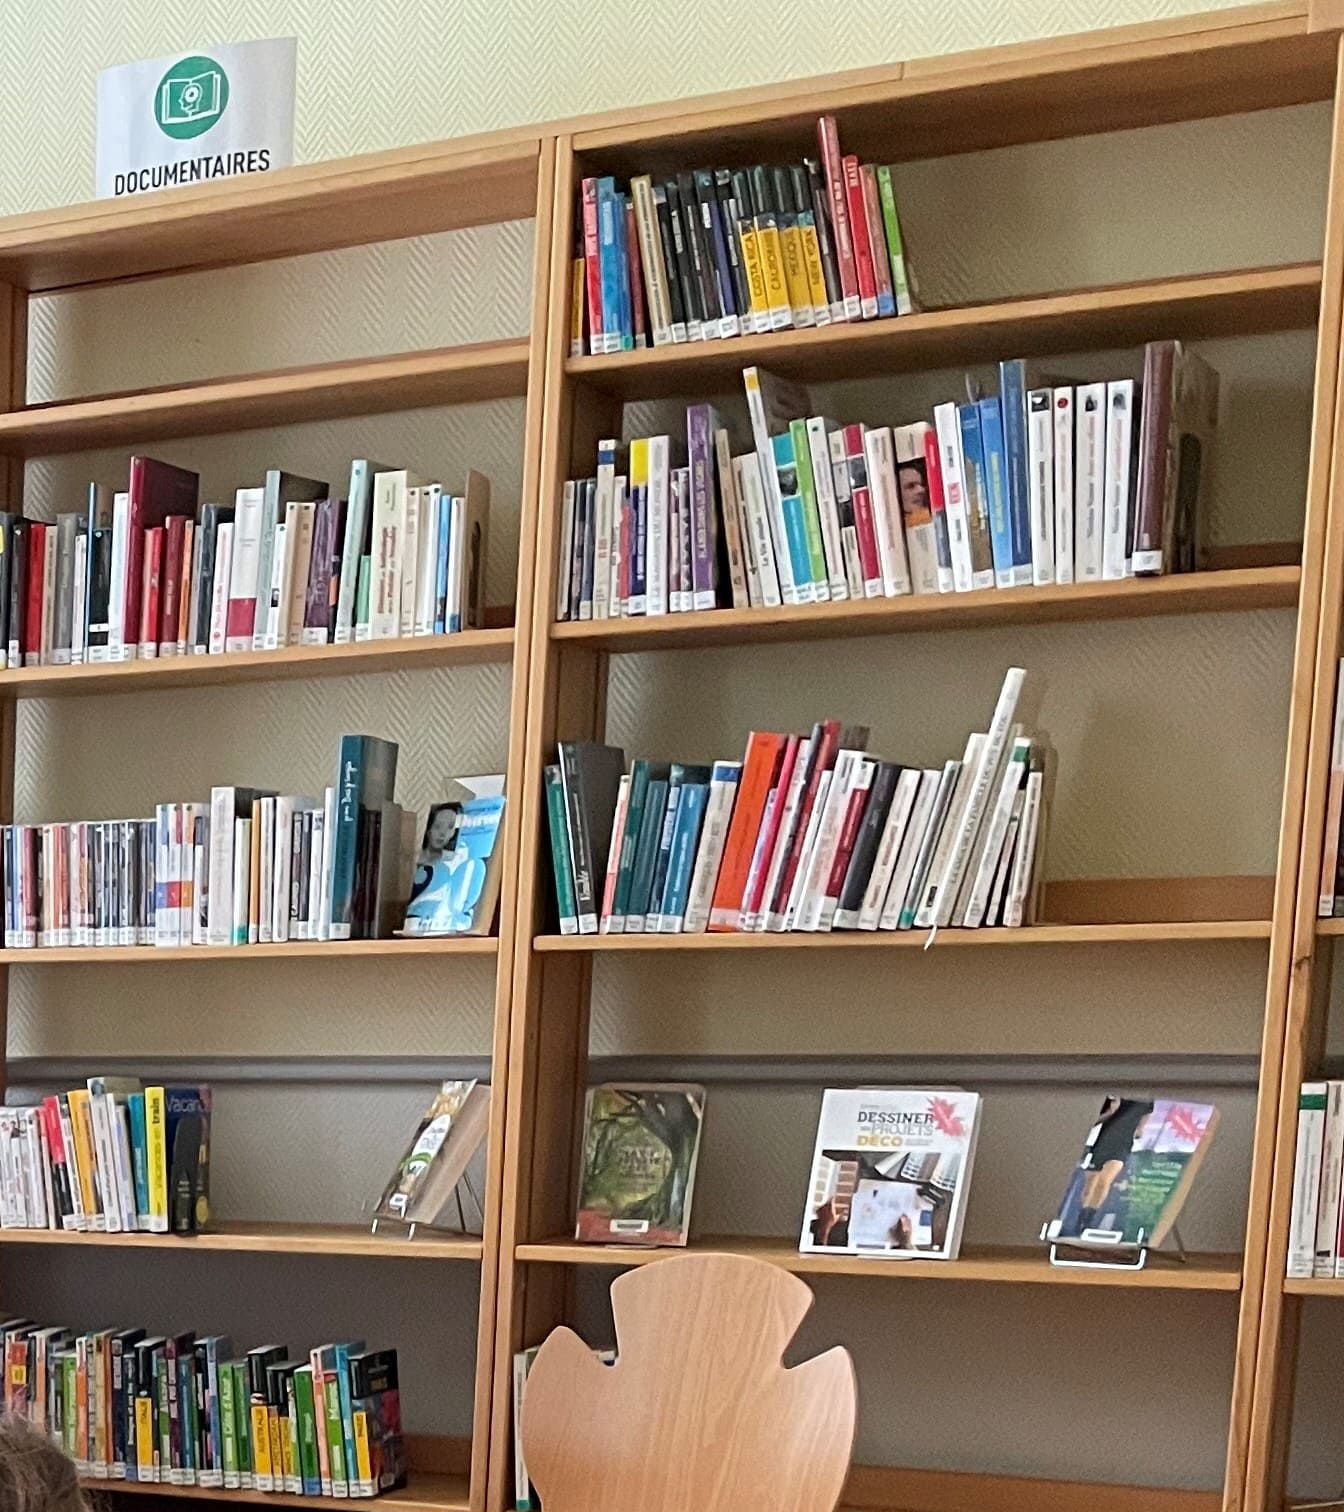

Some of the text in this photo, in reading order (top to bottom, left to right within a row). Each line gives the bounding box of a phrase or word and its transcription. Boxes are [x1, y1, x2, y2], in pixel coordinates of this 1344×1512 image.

[114, 149, 270, 196] DOCUMENTAIRES
[746, 235, 762, 297] COSTA RICA
[764, 231, 781, 291] CALIFORNIE
[804, 229, 820, 285] NEW YORK
[151, 1097, 160, 1124] train
[857, 1111, 934, 1123] DESSINER
[871, 1120, 934, 1137] PROJETS
